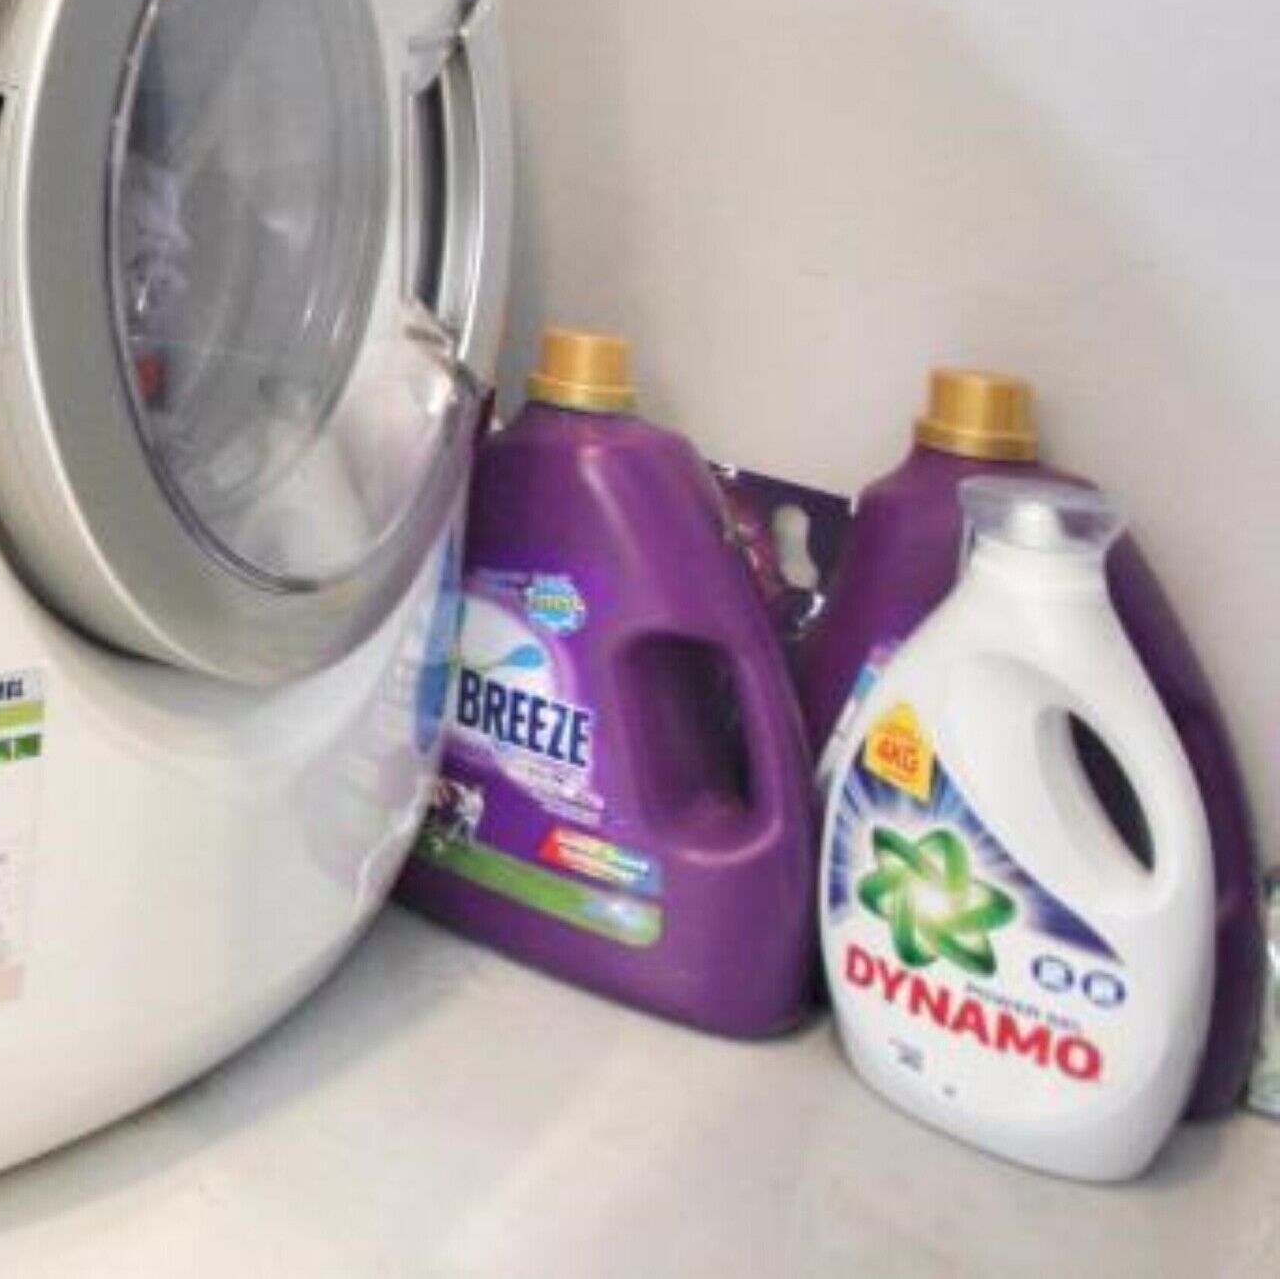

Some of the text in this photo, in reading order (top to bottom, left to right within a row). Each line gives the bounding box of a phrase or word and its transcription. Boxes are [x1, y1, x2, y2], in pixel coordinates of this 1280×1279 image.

[457, 670, 591, 767] BREEZE
[875, 734, 920, 774] 4KG
[845, 944, 1104, 1083] DYNAMO
